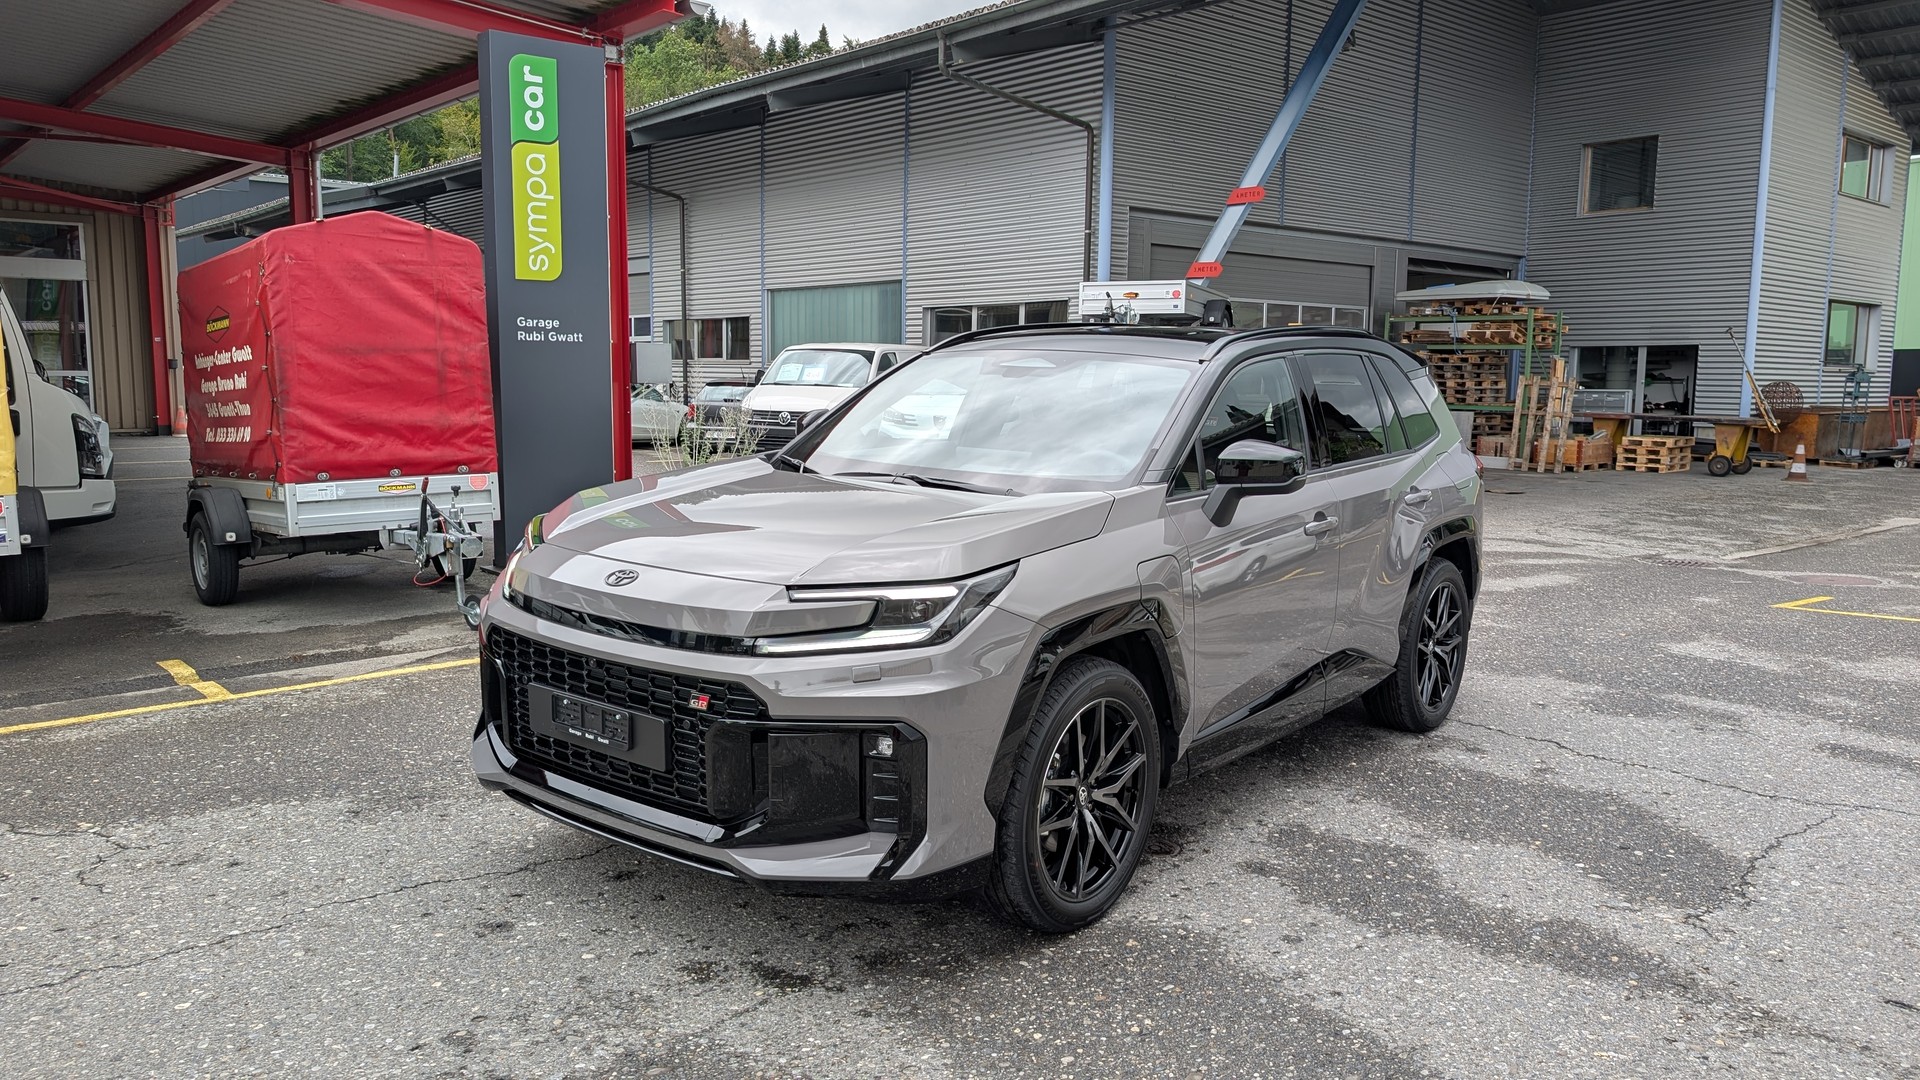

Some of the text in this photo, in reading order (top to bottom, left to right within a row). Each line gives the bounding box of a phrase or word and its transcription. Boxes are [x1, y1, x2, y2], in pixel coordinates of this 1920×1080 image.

[523, 65, 555, 272] sympa car
[516, 316, 560, 329] Garage
[517, 330, 583, 342] Rubi Gwatt
[689, 699, 707, 709] GR
